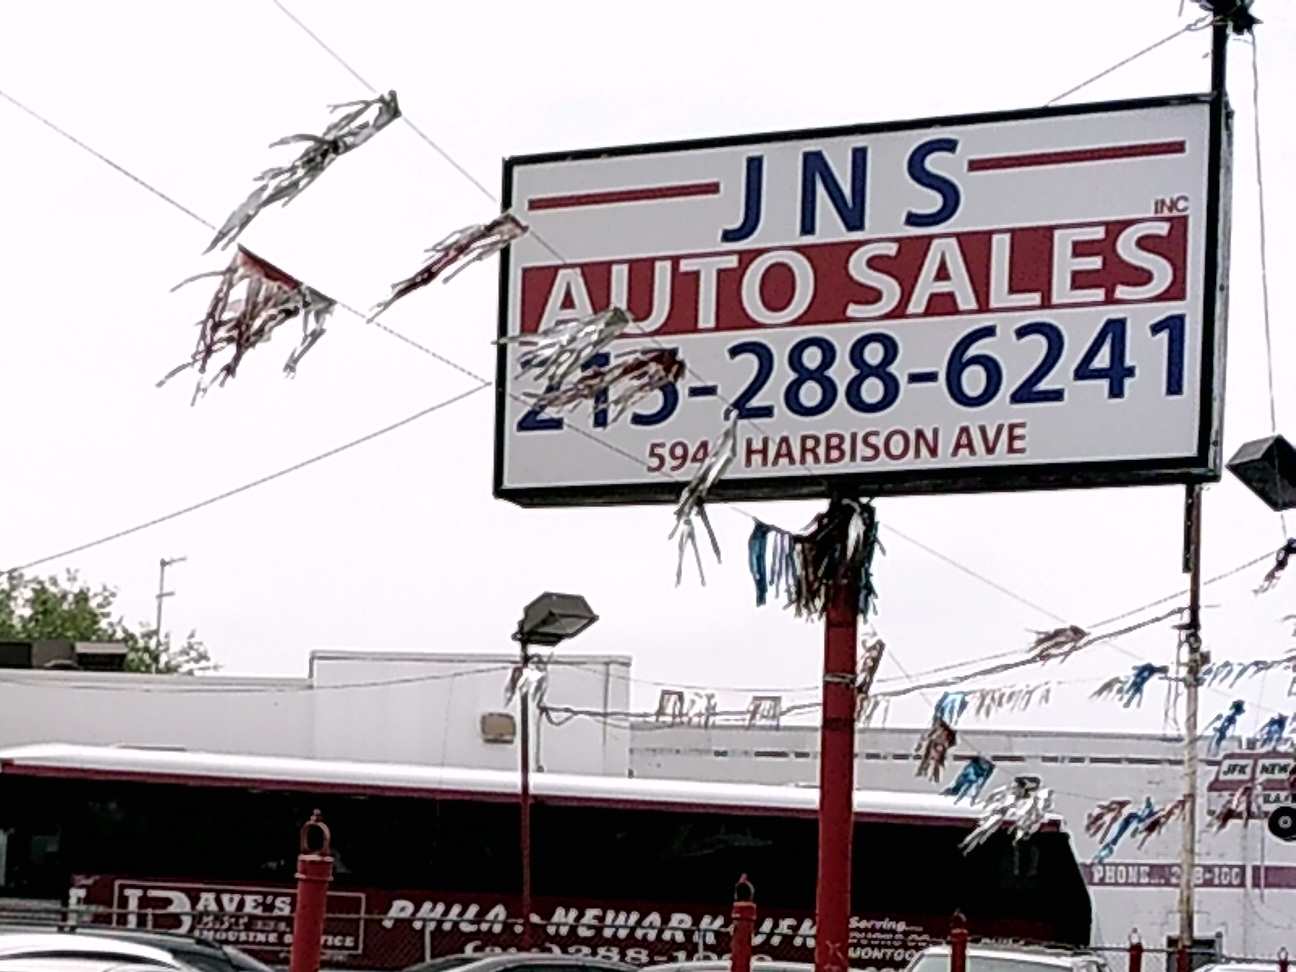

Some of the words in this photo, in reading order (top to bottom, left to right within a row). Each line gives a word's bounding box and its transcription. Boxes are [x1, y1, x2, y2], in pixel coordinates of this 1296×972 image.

[1154, 195, 1189, 215] INC
[536, 249, 815, 339] AUTO
[846, 220, 1174, 318] SALES
[647, 439, 728, 473] 594
[745, 427, 939, 468] HARBISON
[950, 421, 1027, 458] AVE
[283, 932, 355, 947] SVICE
[546, 906, 725, 945] NEWARK
